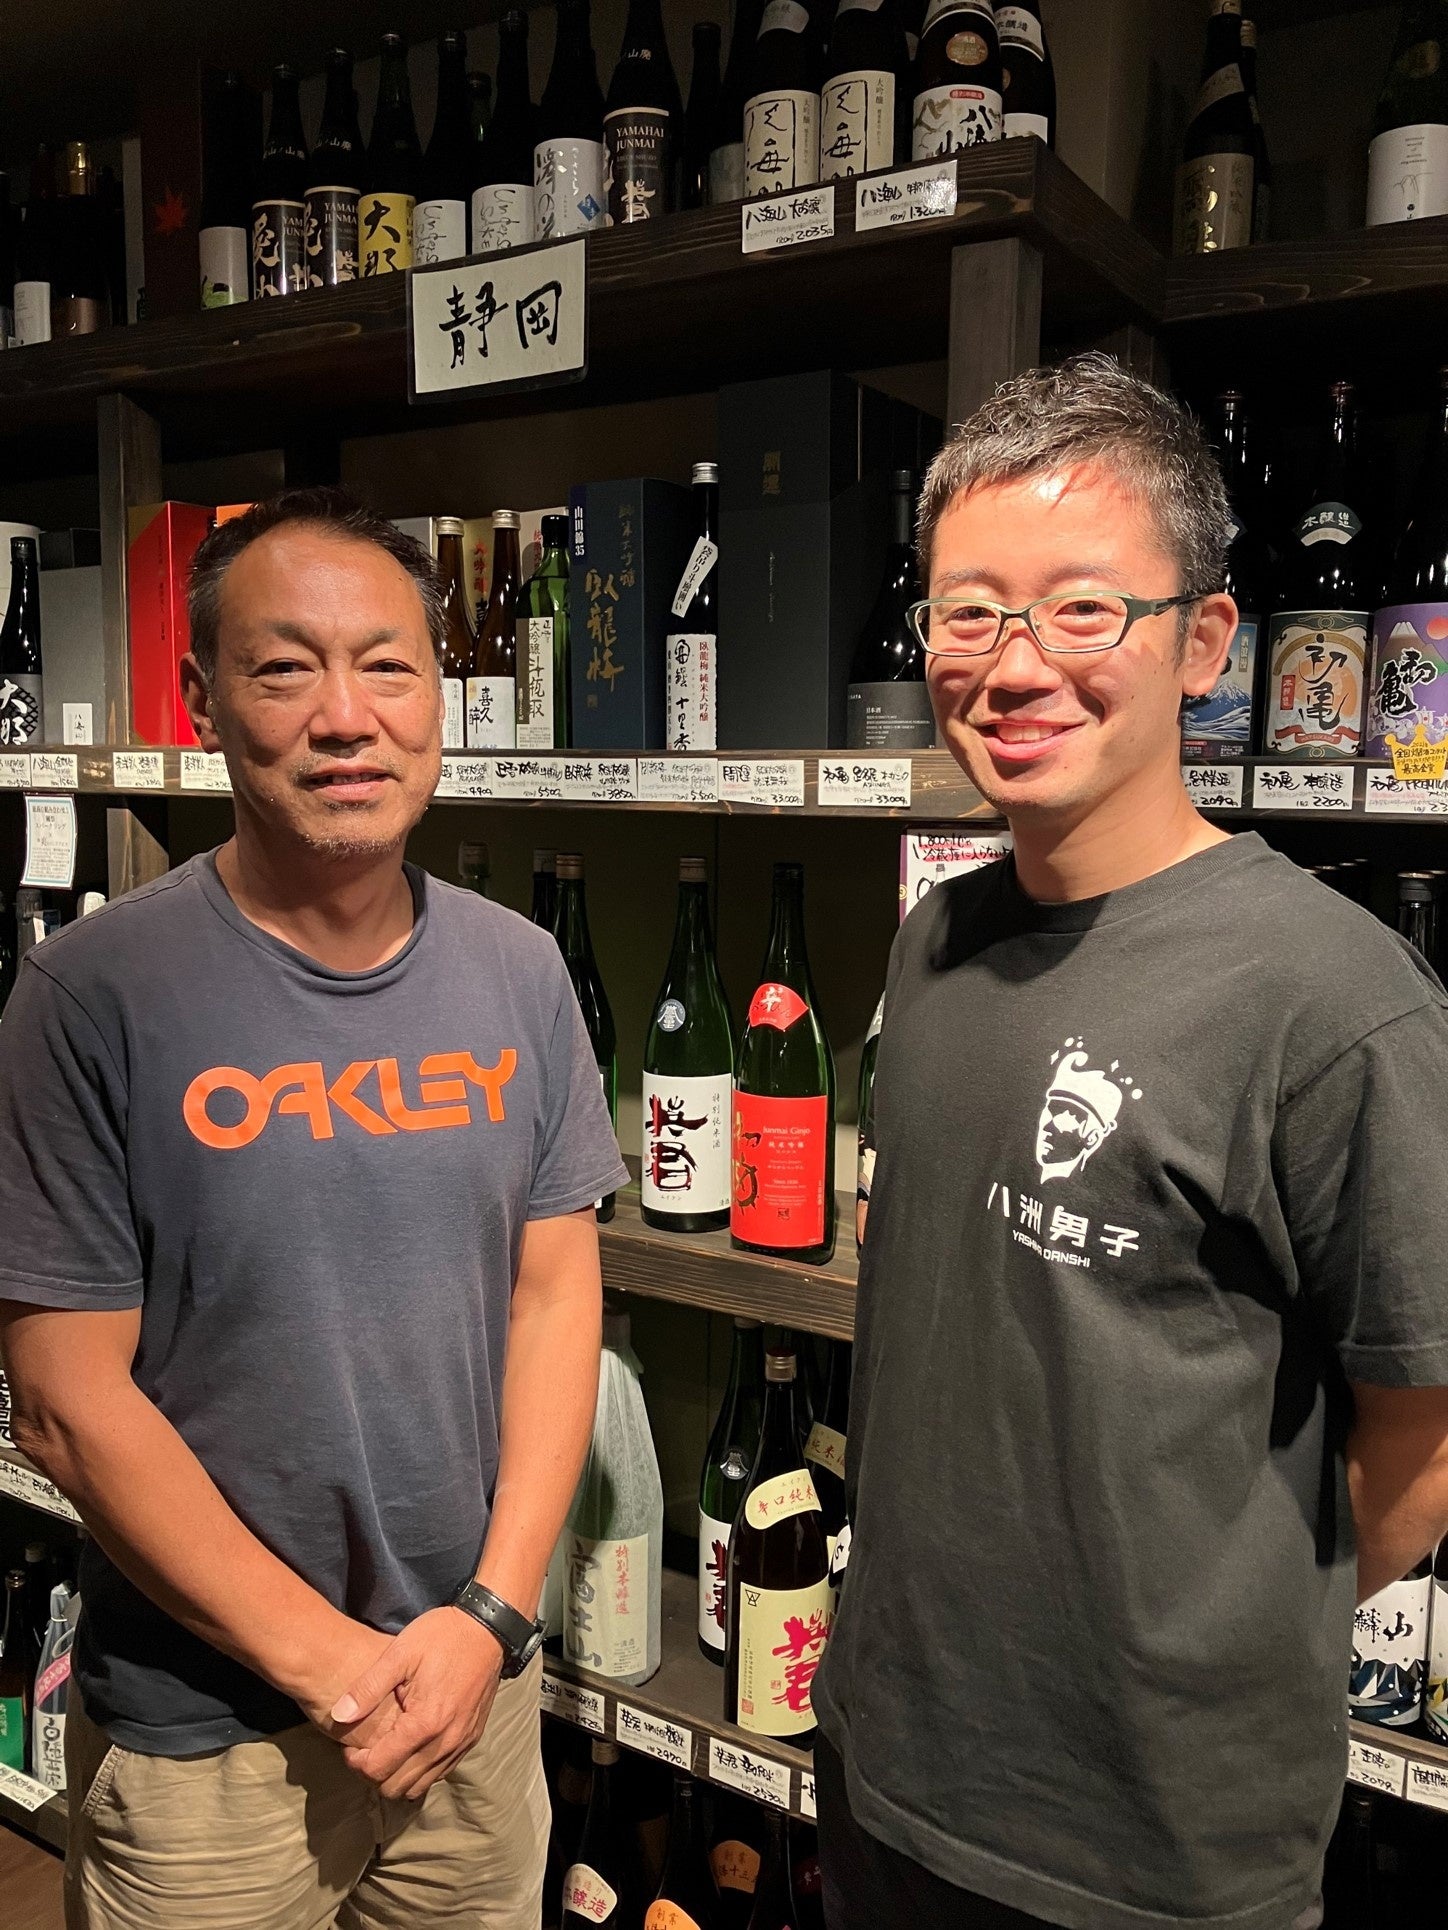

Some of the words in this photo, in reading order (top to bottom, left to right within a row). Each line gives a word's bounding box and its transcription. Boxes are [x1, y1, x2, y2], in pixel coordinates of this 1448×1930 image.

[616, 126, 665, 138] YAMAHAI
[616, 139, 656, 152] JUNMAI
[746, 206, 787, 230] 八海山
[439, 281, 562, 369] 静岡
[1302, 511, 1355, 530] 本醸造
[469, 687, 494, 733] 喜久酔
[699, 674, 709, 722] 純米大吟醸
[723, 764, 752, 783] 開運
[1401, 763, 1436, 775] 最高金賞
[1260, 771, 1300, 791] 初亀
[1302, 772, 1344, 792] 本醸造
[183, 1048, 518, 1150] OAKLEY
[712, 1093, 722, 1150] 特別純米酒
[763, 1126, 788, 1136] Junmai
[790, 1126, 811, 1137] Ginjo
[987, 1182, 1140, 1258] 八洲男子
[1043, 1248, 1091, 1269] DANSHI
[757, 1484, 816, 1517] 辛口純米
[615, 1544, 630, 1615] 特別本醸造
